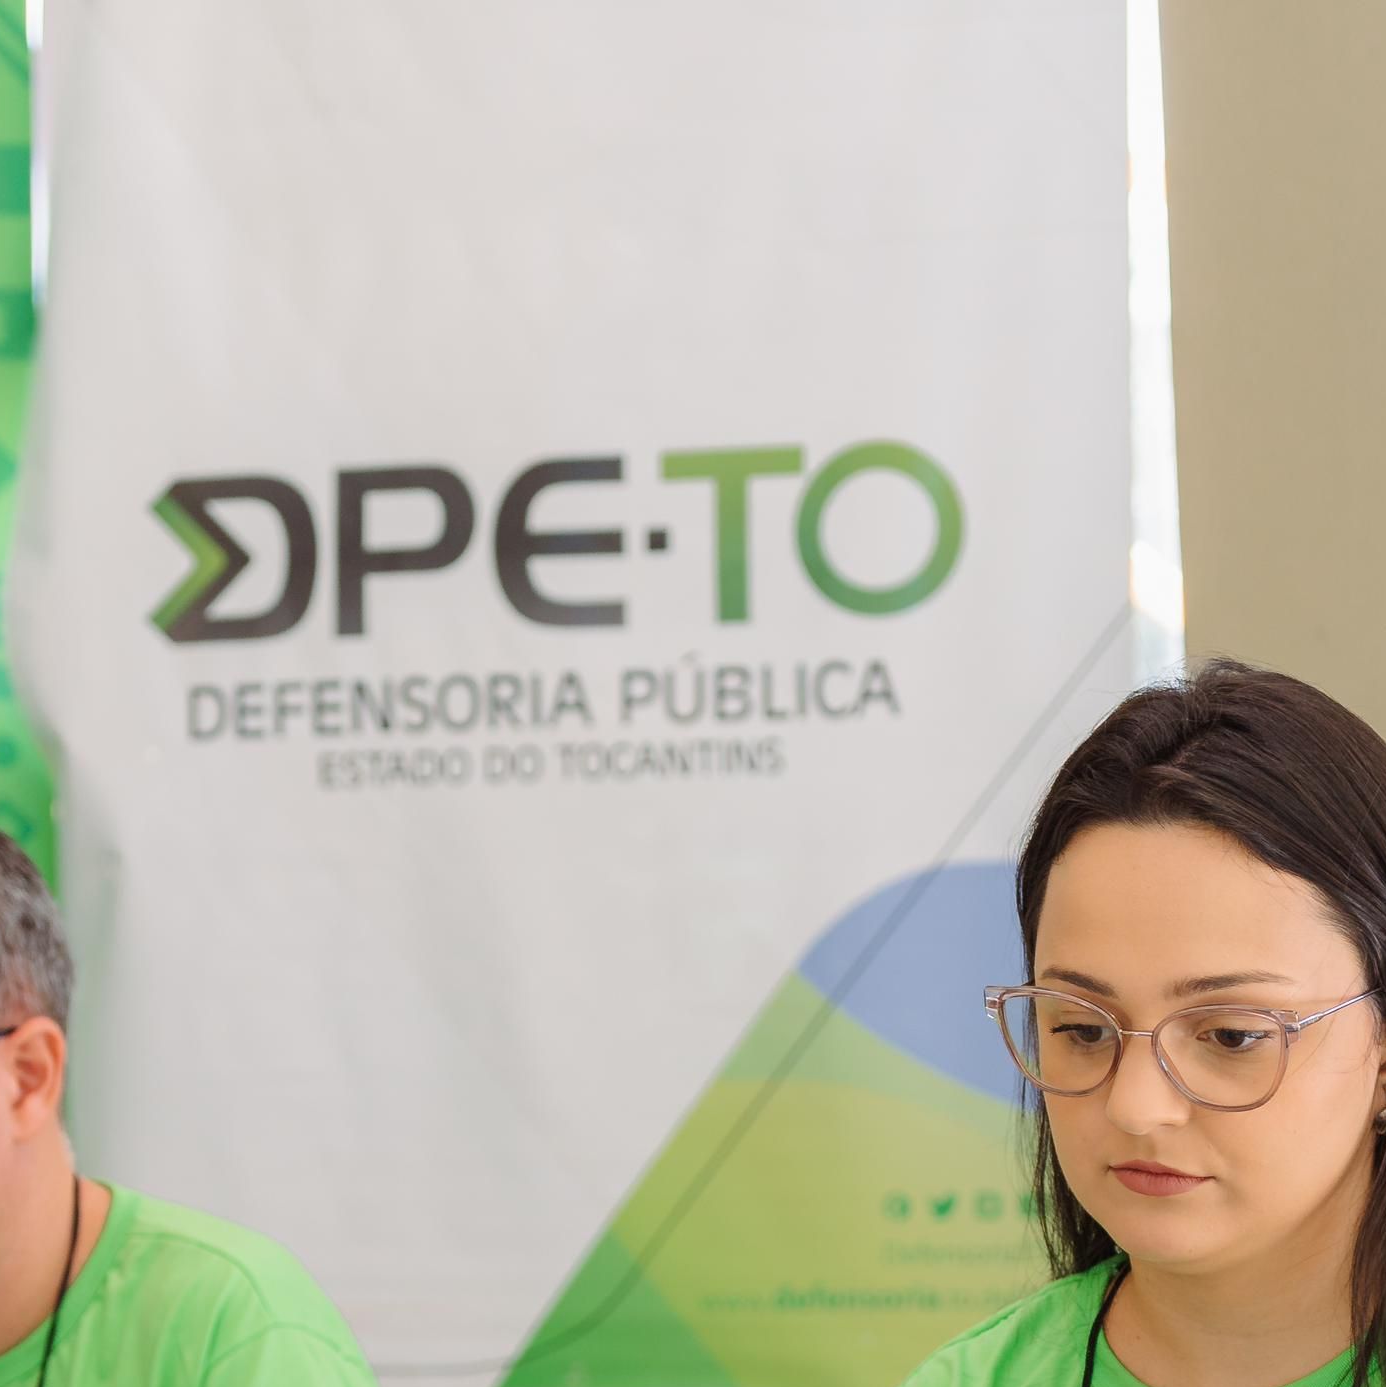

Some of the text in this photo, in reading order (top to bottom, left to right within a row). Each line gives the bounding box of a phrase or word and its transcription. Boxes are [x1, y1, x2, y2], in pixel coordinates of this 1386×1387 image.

[187, 652, 901, 742] DEFENSORIA PÚBLICA
[316, 738, 786, 791] ESTADO DO TOCANTINS
